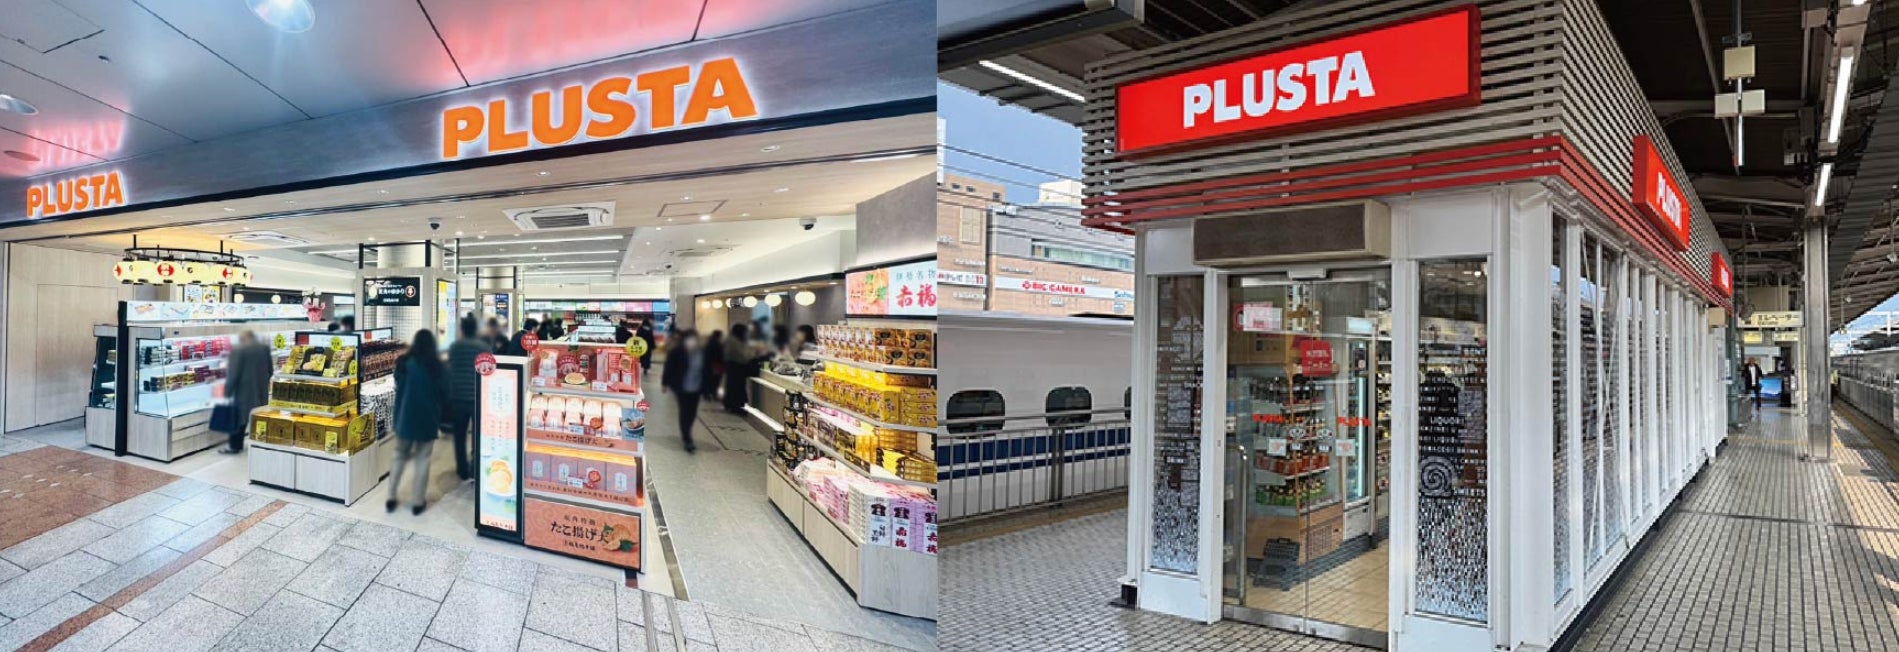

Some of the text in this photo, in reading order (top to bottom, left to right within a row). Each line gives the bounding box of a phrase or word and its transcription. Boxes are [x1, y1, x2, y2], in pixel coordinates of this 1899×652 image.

[443, 58, 756, 158] PLUSTA
[1183, 50, 1376, 129] PLUSTA
[26, 172, 124, 217] PLUSTA
[896, 283, 937, 308] 赤福
